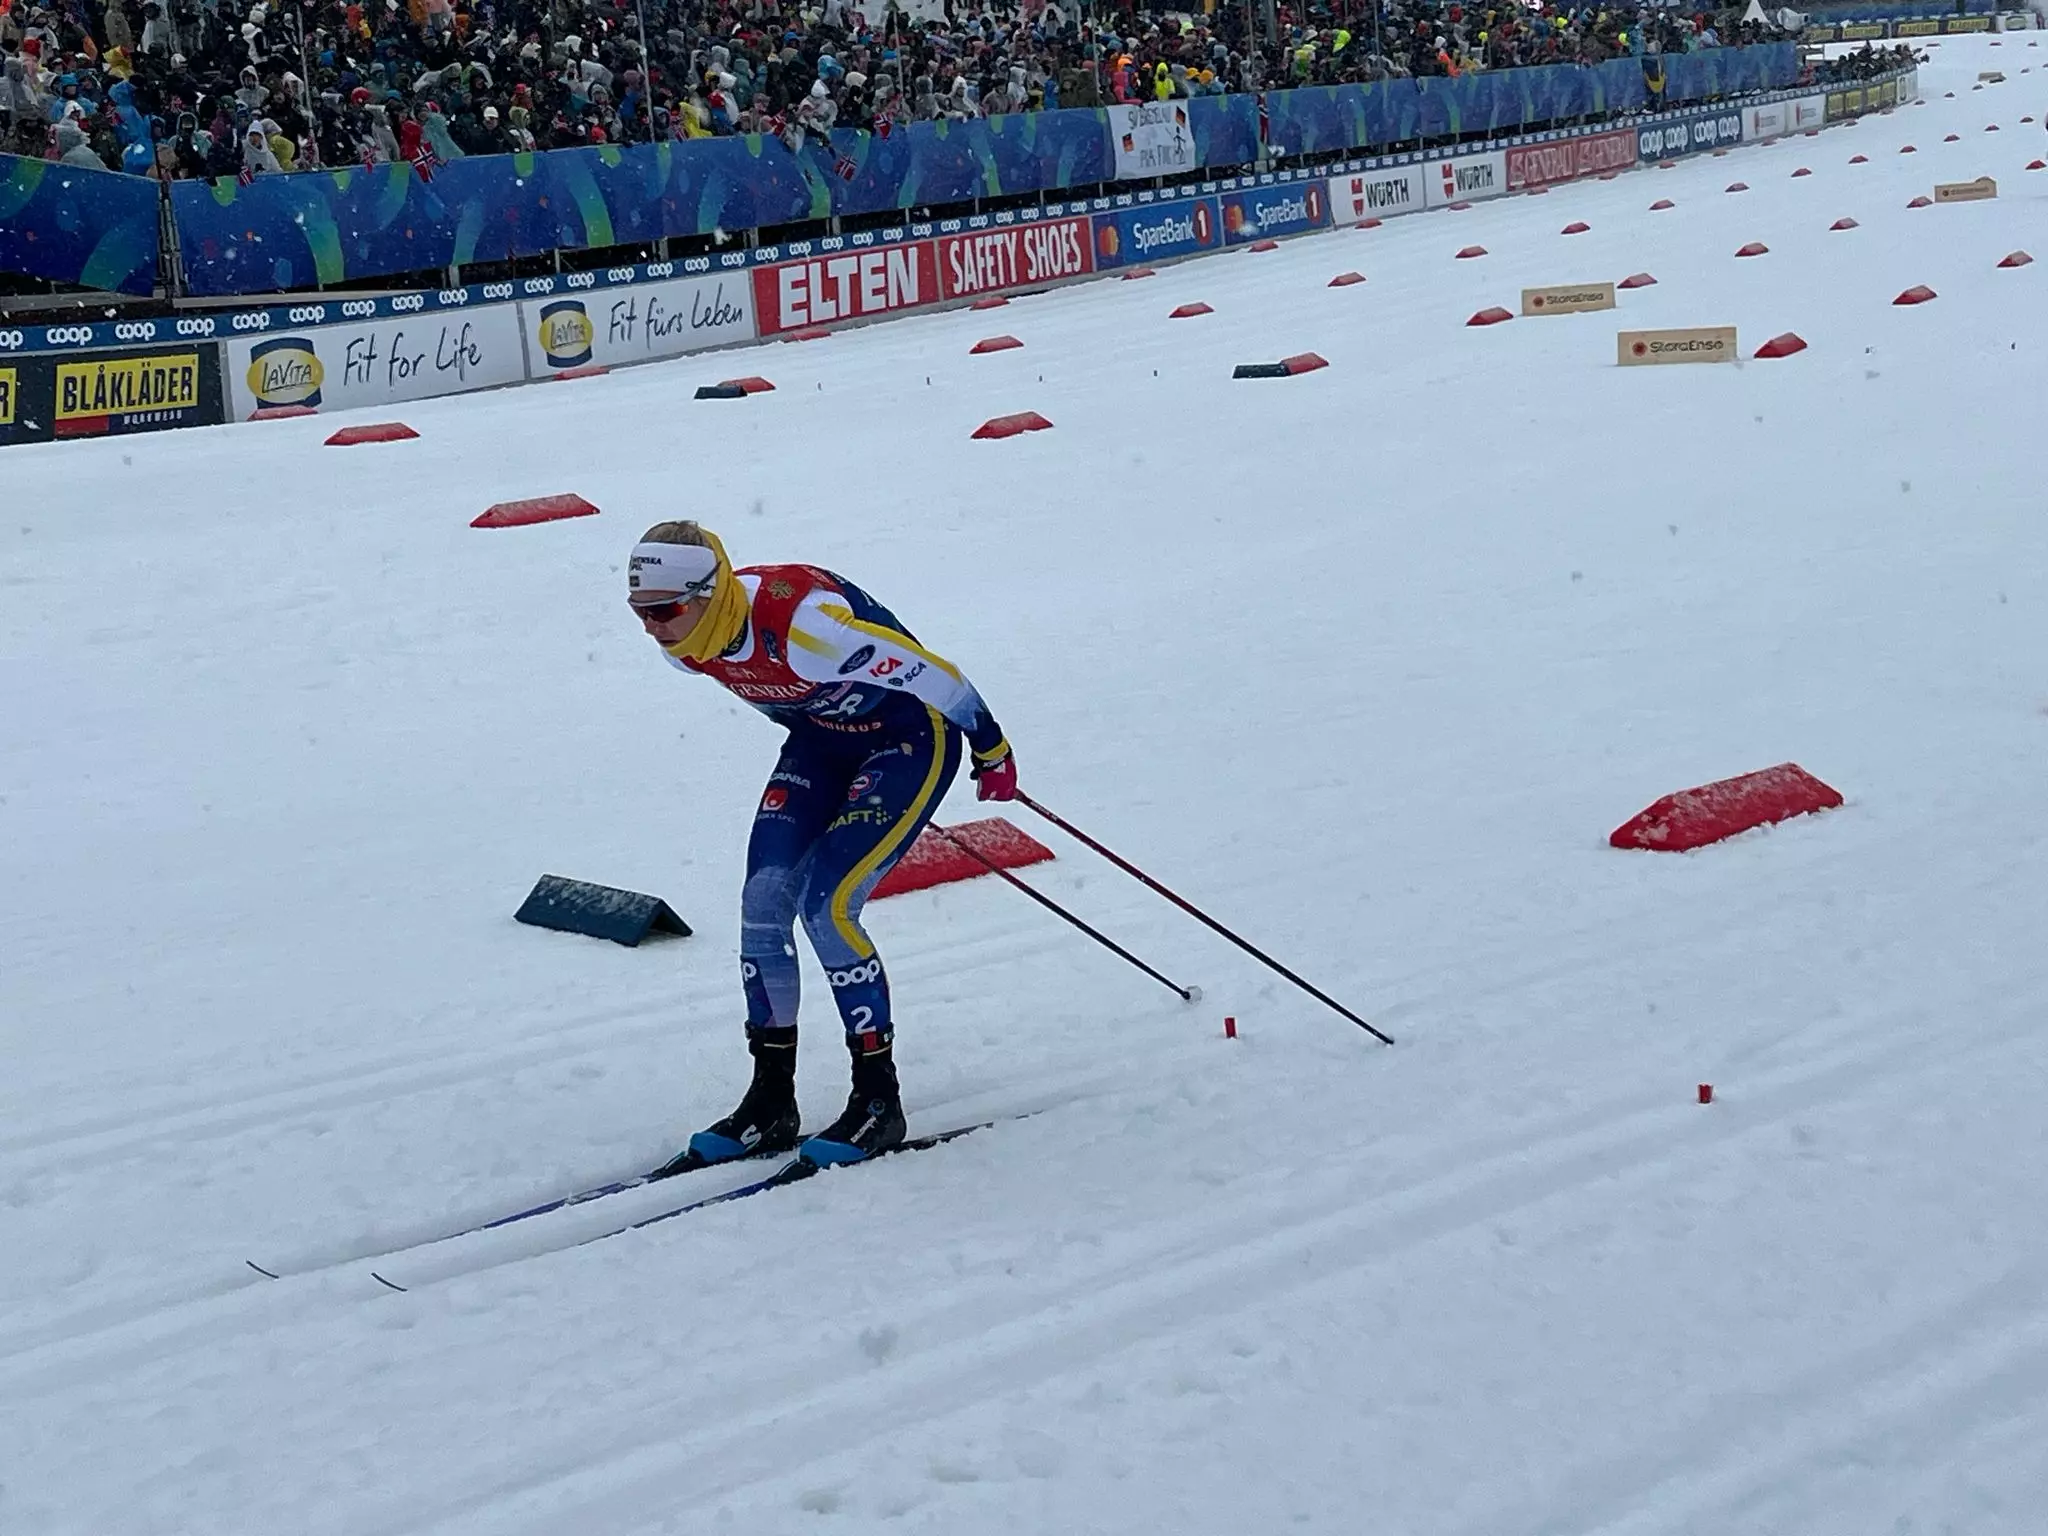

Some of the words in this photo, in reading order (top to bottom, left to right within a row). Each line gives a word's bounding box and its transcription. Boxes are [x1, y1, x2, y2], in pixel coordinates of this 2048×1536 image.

[1640, 129, 1664, 157] coop
[1255, 199, 1308, 229] SpareBank
[1309, 191, 1319, 218] 1
[1365, 178, 1410, 208] WÜRTH
[1133, 217, 1196, 254] SpareBank
[1197, 208, 1209, 238] 1
[950, 231, 1018, 296] SAFETY
[1024, 222, 1082, 282] SHOES
[47, 327, 92, 345] coop
[116, 322, 155, 341] coop
[177, 319, 214, 336] coop
[233, 312, 269, 329] coop
[290, 306, 324, 323] coop
[342, 299, 376, 317] coop
[391, 294, 424, 312] coop
[438, 288, 468, 305] coop
[483, 282, 513, 299] coop
[524, 277, 554, 294] coop
[567, 272, 595, 288] coop
[607, 267, 635, 283] coop
[647, 262, 673, 278] coop
[684, 256, 710, 272] coop
[721, 252, 746, 267] coop
[755, 246, 779, 262] coop
[789, 241, 812, 256] coop
[821, 236, 844, 250] coop
[852, 231, 874, 246] coop
[882, 227, 904, 241] coop
[778, 247, 920, 329] ELTEN
[608, 296, 637, 344] Fit
[645, 297, 683, 351] fürs
[691, 283, 744, 329] Leben
[344, 333, 379, 386] Fit
[388, 331, 426, 391] for
[435, 322, 483, 382] Life
[62, 361, 194, 413] BLÅKLÄDER
[846, 649, 871, 671] Ford
[868, 656, 904, 678] ICA
[903, 661, 928, 682] SCA
[850, 1005, 877, 1034] 2
